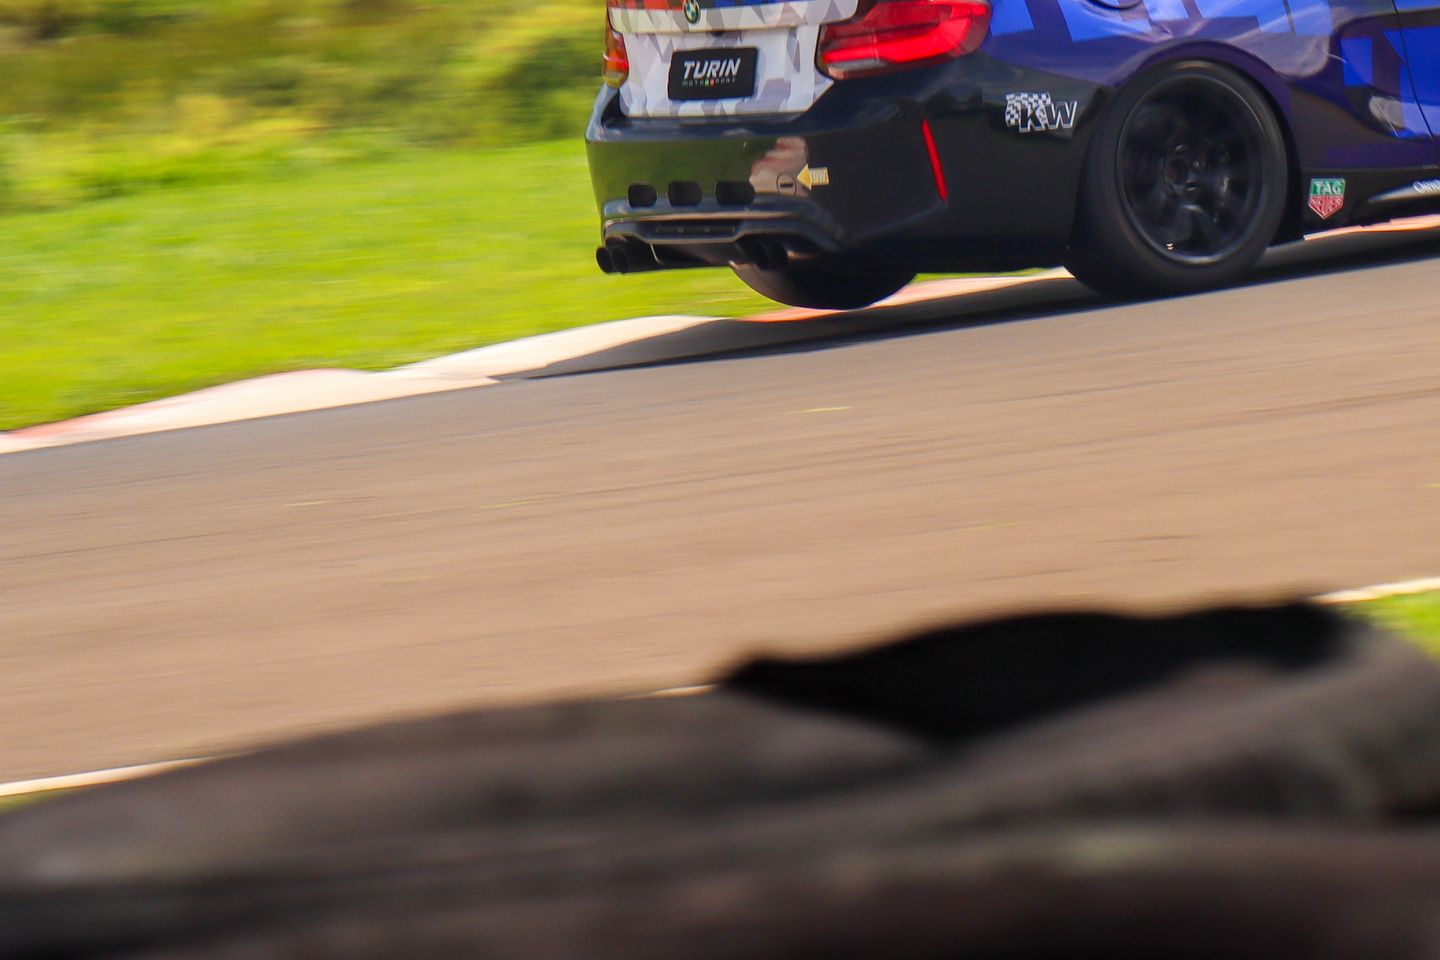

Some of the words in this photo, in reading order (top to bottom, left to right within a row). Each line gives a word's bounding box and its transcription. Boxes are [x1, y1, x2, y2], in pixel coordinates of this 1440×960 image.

[683, 57, 741, 80] TURIN
[1018, 100, 1078, 133] KW
[1312, 180, 1344, 195] TAG
